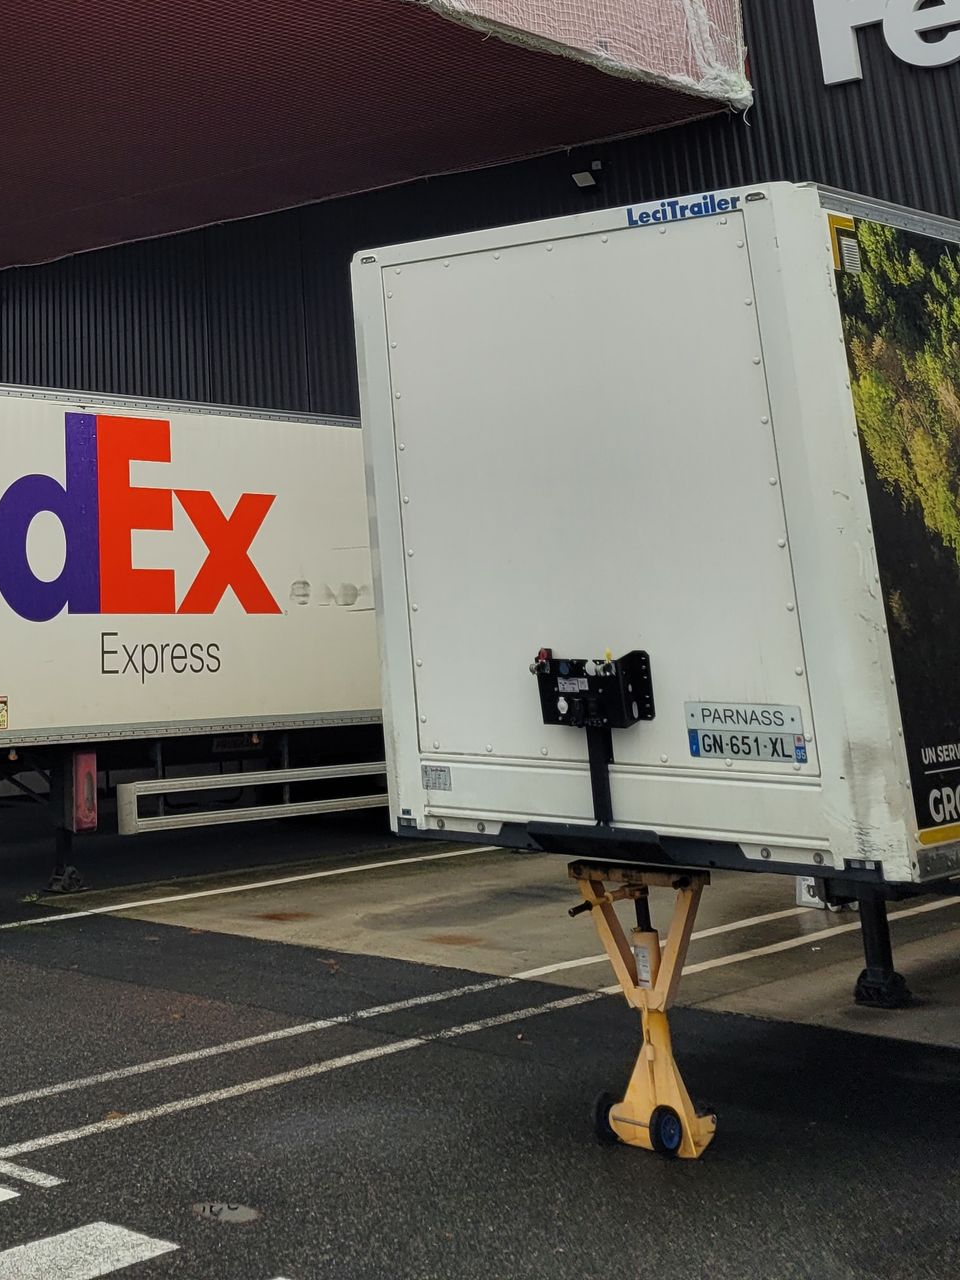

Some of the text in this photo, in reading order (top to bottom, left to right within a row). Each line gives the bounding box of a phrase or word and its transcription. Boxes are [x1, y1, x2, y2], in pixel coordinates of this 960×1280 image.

[626, 194, 740, 226] LeciTrailer
[101, 632, 221, 684] Express
[701, 708, 785, 727] PARNASS
[921, 746, 937, 765] UN
